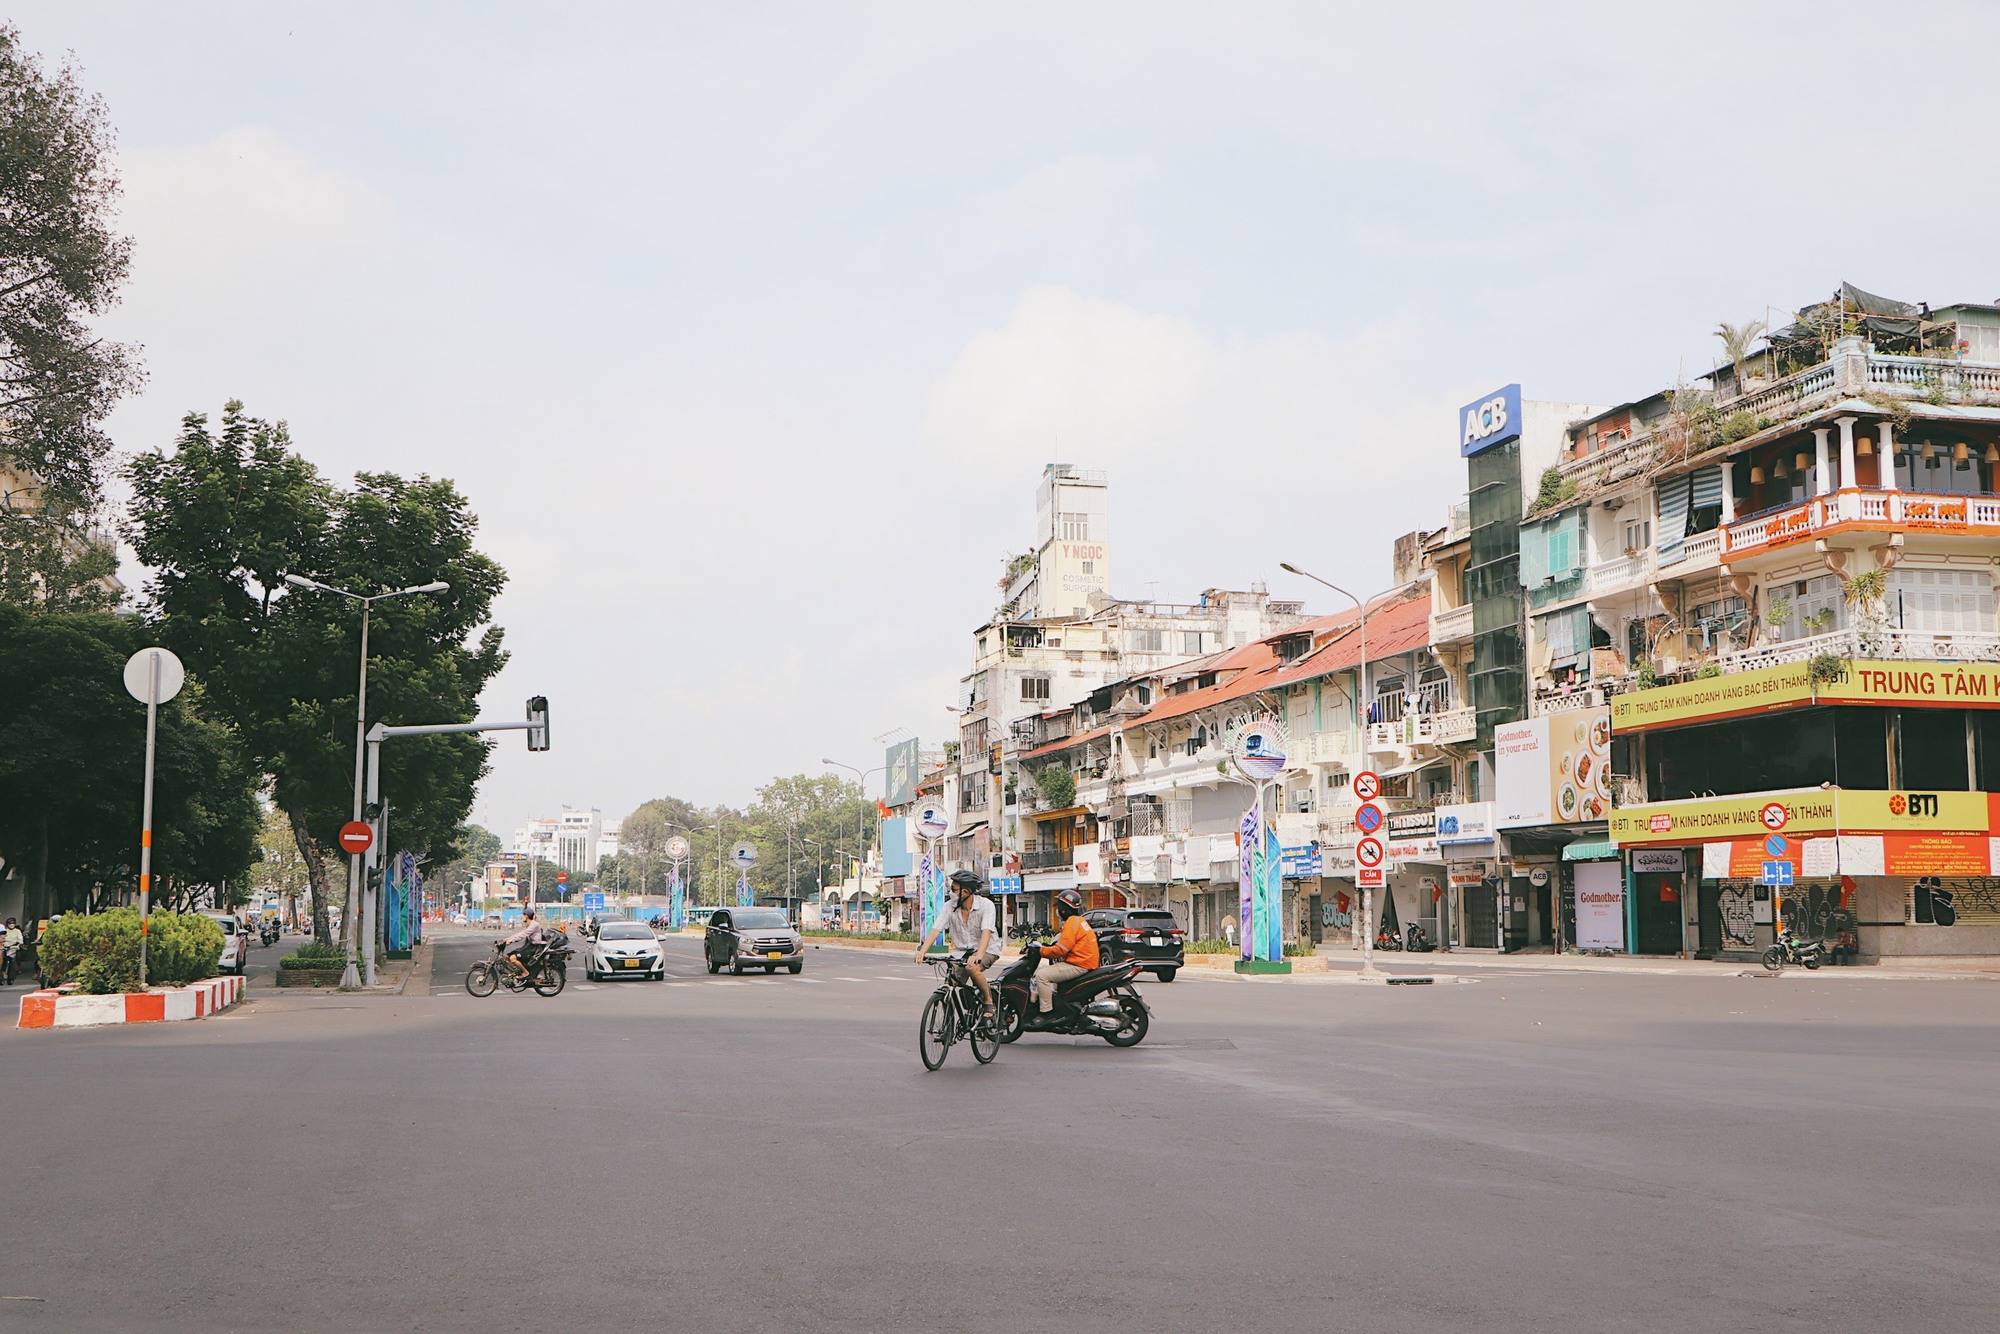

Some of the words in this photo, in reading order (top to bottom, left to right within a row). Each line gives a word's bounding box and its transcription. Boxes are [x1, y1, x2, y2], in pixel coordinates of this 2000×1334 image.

[1464, 397, 1507, 446] ACB
[1063, 544, 1070, 558] Y
[1063, 574, 1104, 584] COSMETIC
[1063, 583, 1104, 593] SURGERY
[1858, 670, 1935, 695] TRUNG
[1940, 667, 1987, 696] TÂM
[1635, 700, 1659, 715] TRUNG
[1659, 697, 1675, 711] TÂM
[1676, 695, 1694, 708] KINH
[1694, 691, 1720, 705] DOANH
[1721, 685, 1743, 700] VÀNG
[1745, 682, 1761, 699] BẠC
[1762, 675, 1779, 693] BẾN
[1780, 673, 1809, 690] THÀNH
[1497, 729, 1533, 744] Godmother.
[1498, 744, 1505, 756] in
[1505, 741, 1521, 758] your
[1521, 738, 1539, 751] area!
[1908, 793, 1939, 817] BTJ
[1400, 811, 1435, 828] TISSOT
[1438, 816, 1459, 835] ACB
[1634, 819, 1651, 832] TRU
[1680, 815, 1699, 829] KINH
[1701, 811, 1730, 827] DOANH
[1731, 807, 1756, 824] VÀNG
[1785, 802, 1798, 821] ẾN
[1800, 802, 1833, 820] THÀNH
[1364, 869, 1377, 878] CẤM
[1580, 892, 1621, 903] Godmother.
[1756, 888, 1765, 897] 68
